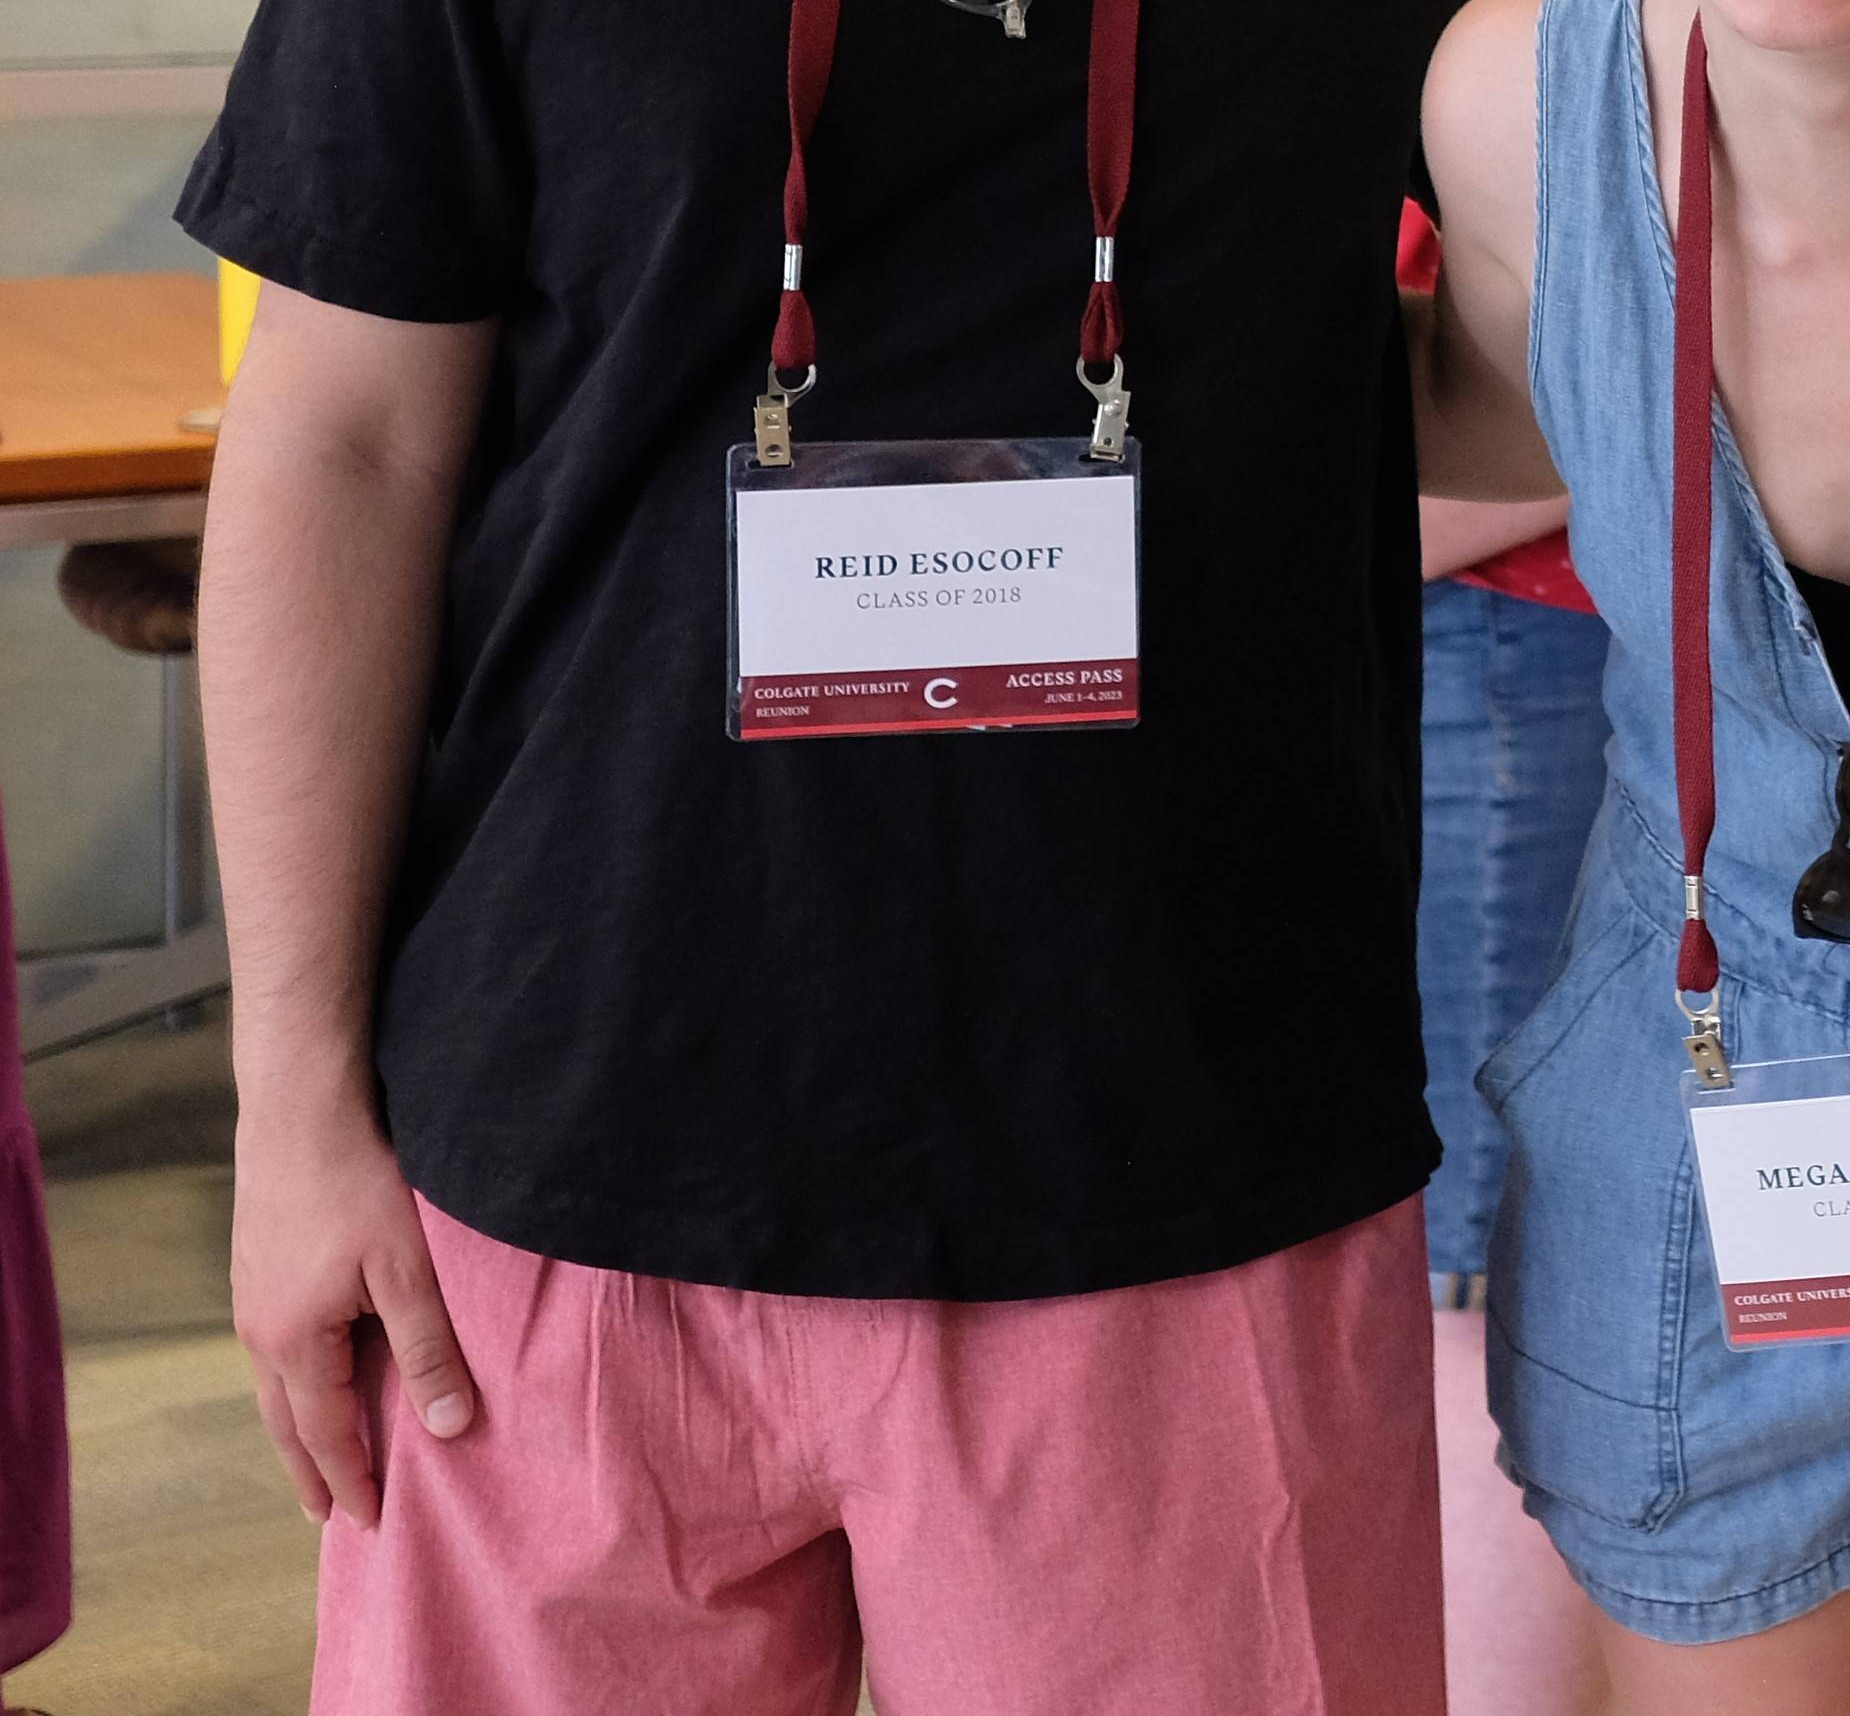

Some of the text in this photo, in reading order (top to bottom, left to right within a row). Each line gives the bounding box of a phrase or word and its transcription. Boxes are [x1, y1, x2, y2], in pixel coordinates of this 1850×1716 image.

[814, 546, 1065, 579] REID ESOCOFF
[856, 586, 1022, 609] CLASS OF 2018
[1005, 668, 1124, 688] ACCESS PASS
[753, 681, 911, 700] COLGATE UNIVERSITY
[923, 677, 959, 709] C
[1044, 692, 1075, 704] JUNE
[755, 705, 810, 718] REUNION
[1733, 1292, 1794, 1306] COLGATE
